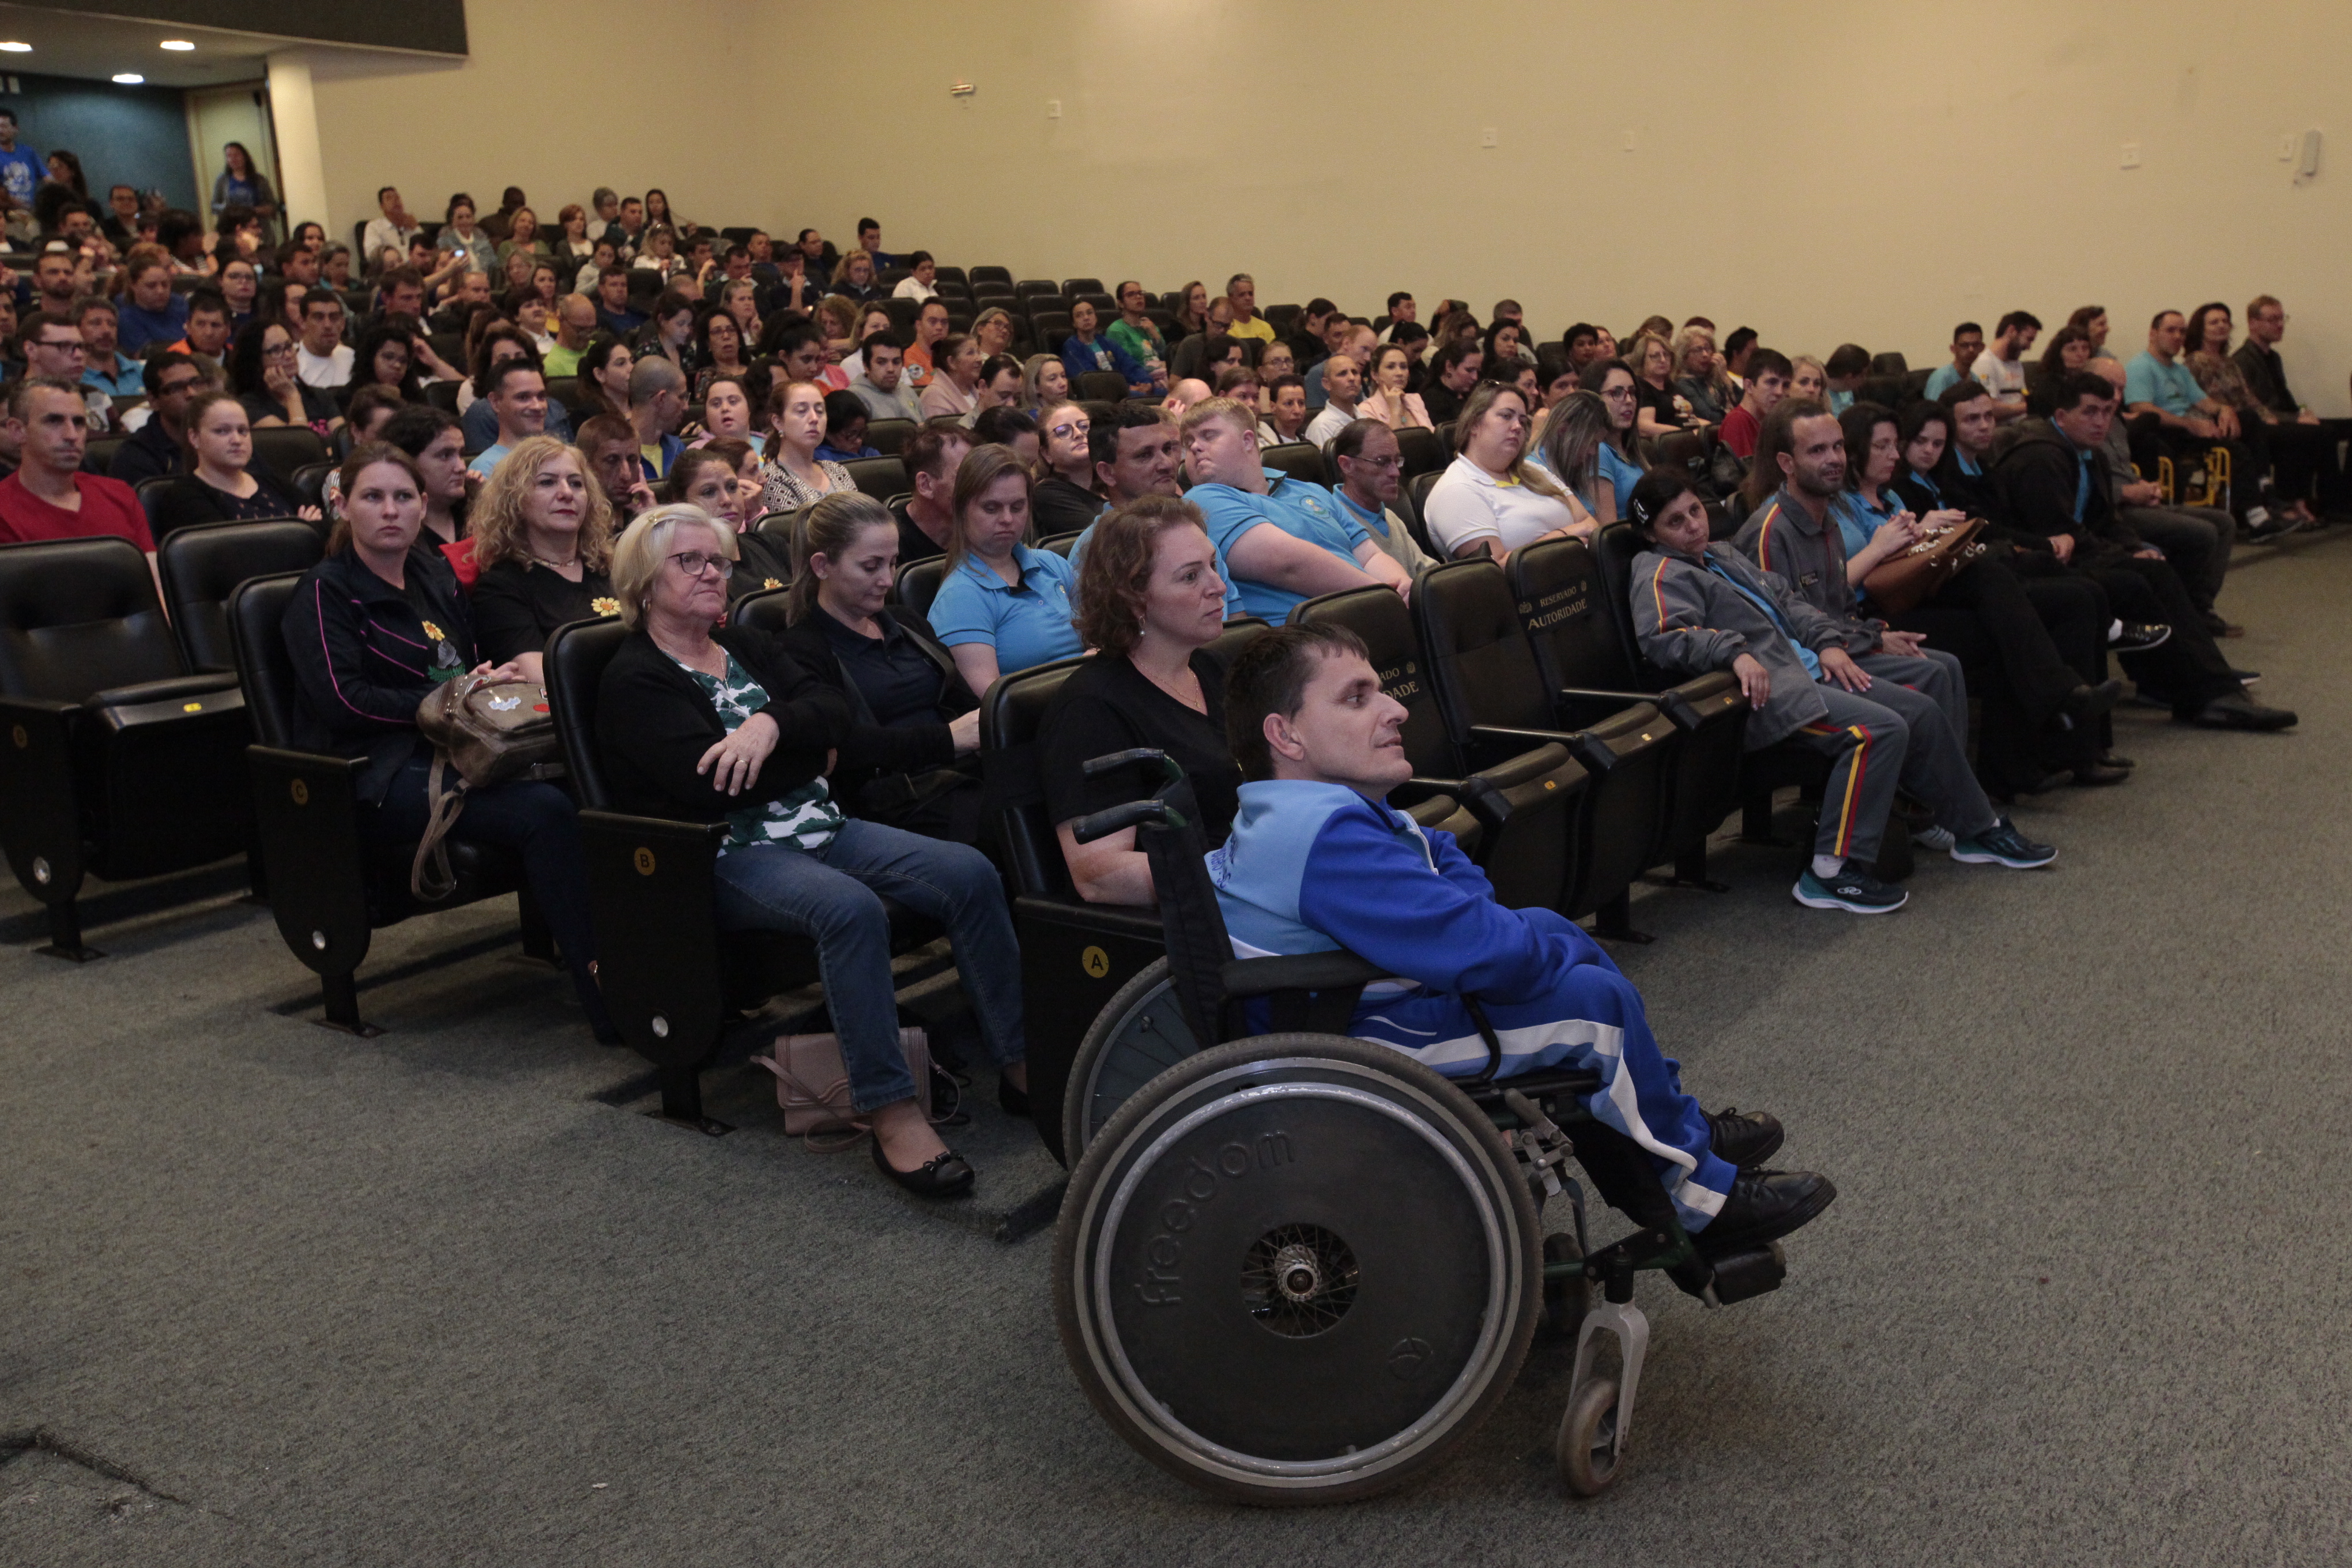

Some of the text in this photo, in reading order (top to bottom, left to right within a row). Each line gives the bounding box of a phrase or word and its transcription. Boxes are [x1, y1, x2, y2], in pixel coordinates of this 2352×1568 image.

[1539, 586, 1577, 608] RESERVADO
[1528, 598, 1588, 630] AUTORIDADE
[296, 785, 304, 798] C
[639, 853, 650, 868] B
[1091, 953, 1104, 971] A
[1133, 1129, 1295, 1307] freedom
